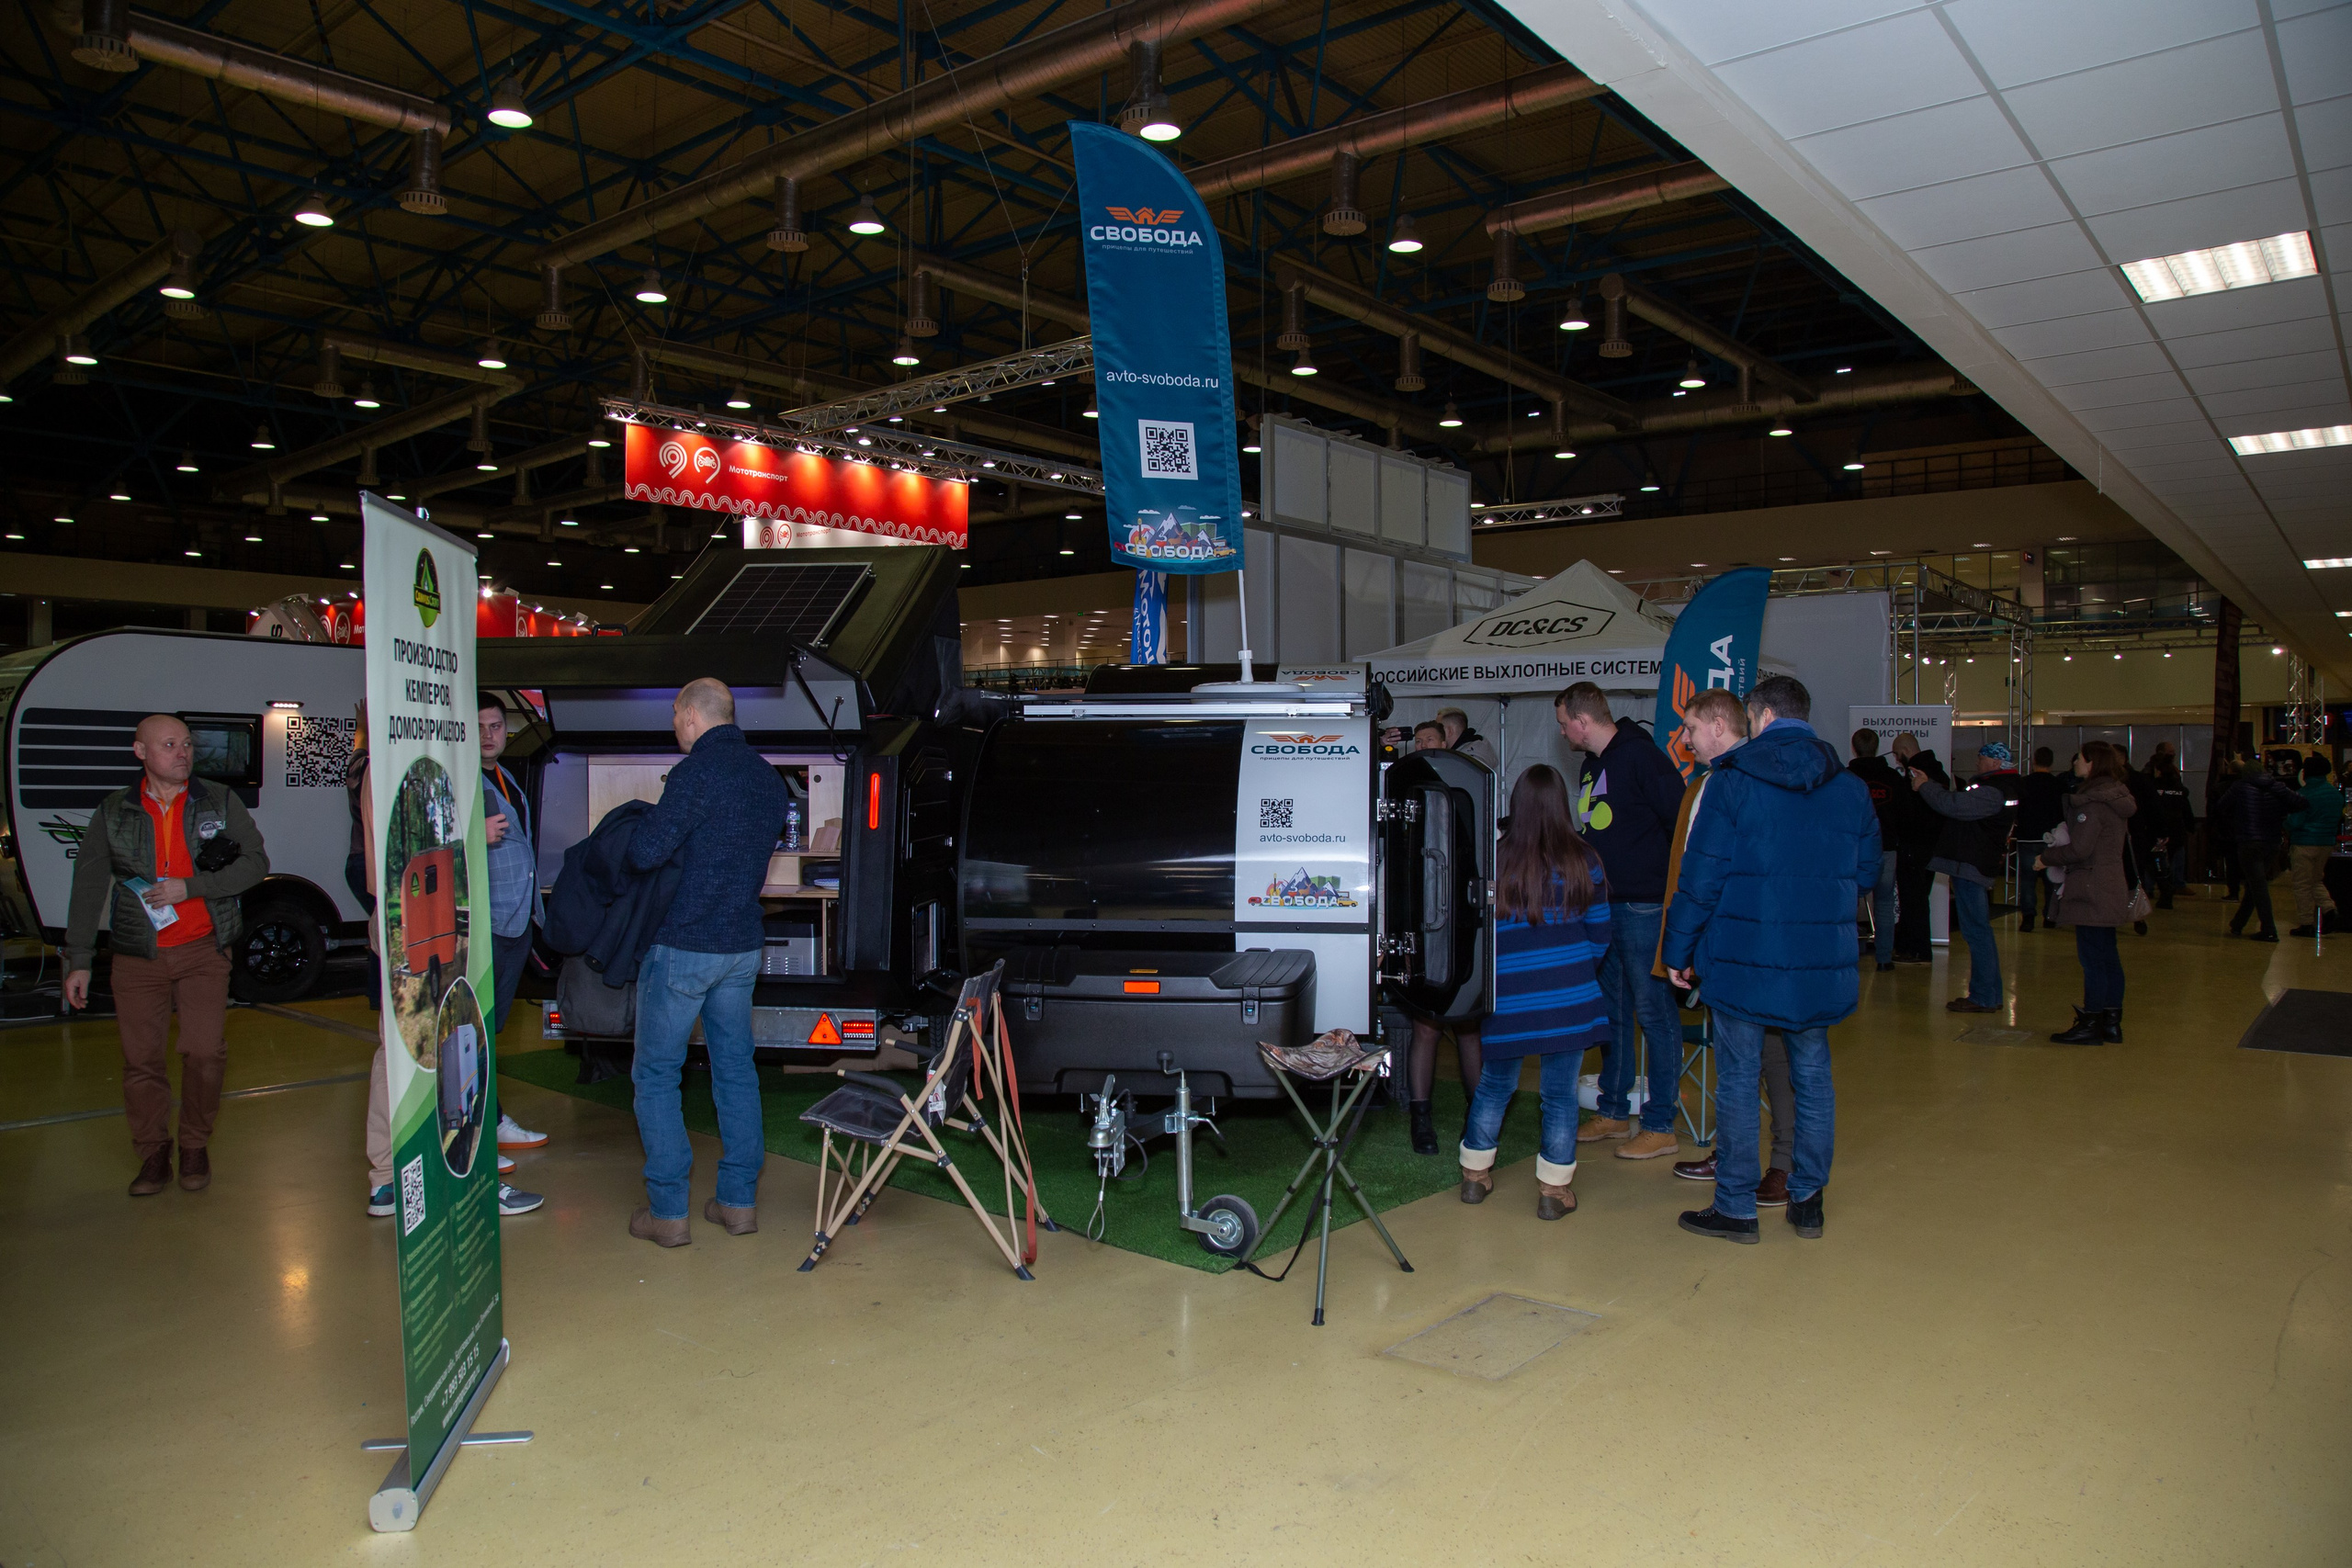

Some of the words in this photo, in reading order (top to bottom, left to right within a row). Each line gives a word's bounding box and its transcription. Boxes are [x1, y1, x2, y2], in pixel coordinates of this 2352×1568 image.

[1090, 226, 1204, 247] СВОБОДА
[1106, 369, 1218, 389] avto-svoboda.ru
[729, 465, 788, 482] Мототранспорт
[1125, 543, 1216, 560] СВОБОДА
[1487, 616, 1589, 637] DC&CS
[393, 637, 458, 675] ПРОИЗВОДСТВО
[1371, 665, 1469, 683] ОССИЙСКИЕ
[1474, 661, 1586, 680] ВЫХЛОПНЫЕ
[406, 678, 452, 711] КЕМПЕРОВ,
[389, 715, 467, 748] ДОМОВ-ПРИЦЕПОВ
[1873, 729, 1929, 738] ИСТМЫ
[1251, 746, 1360, 755] СВОБОДА
[1260, 834, 1346, 843] avto-svoboda.ru
[1261, 895, 1338, 908] СВОБОДА
